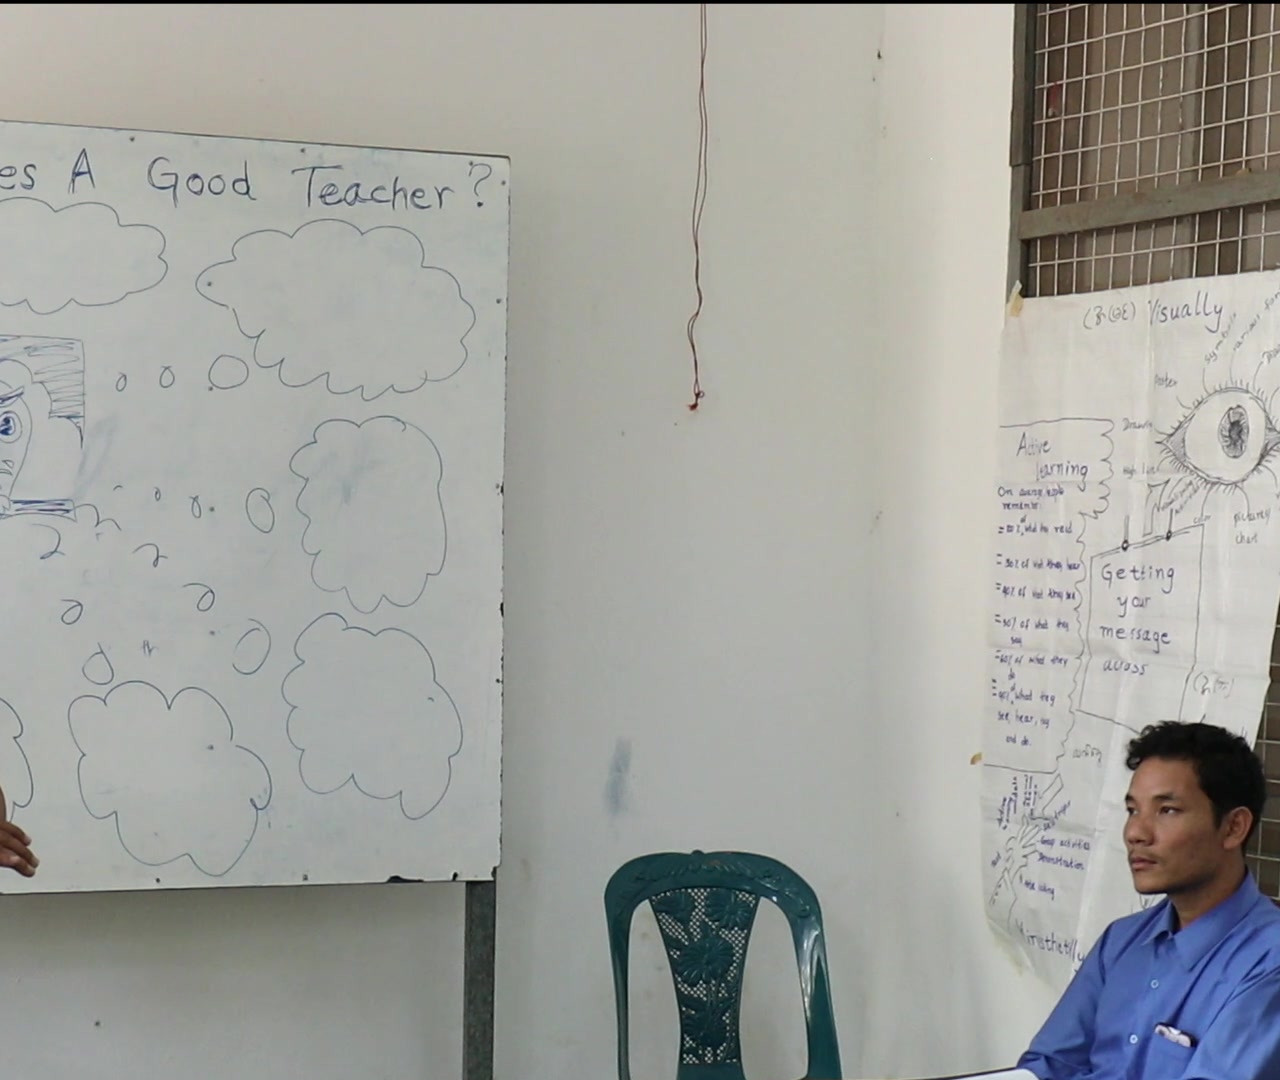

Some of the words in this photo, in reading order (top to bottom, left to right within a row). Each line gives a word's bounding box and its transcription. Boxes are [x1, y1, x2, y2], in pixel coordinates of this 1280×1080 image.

[67, 146, 99, 193] A
[146, 158, 258, 202] Good
[1100, 562, 1175, 594] Getting
[1099, 624, 1172, 654] message
